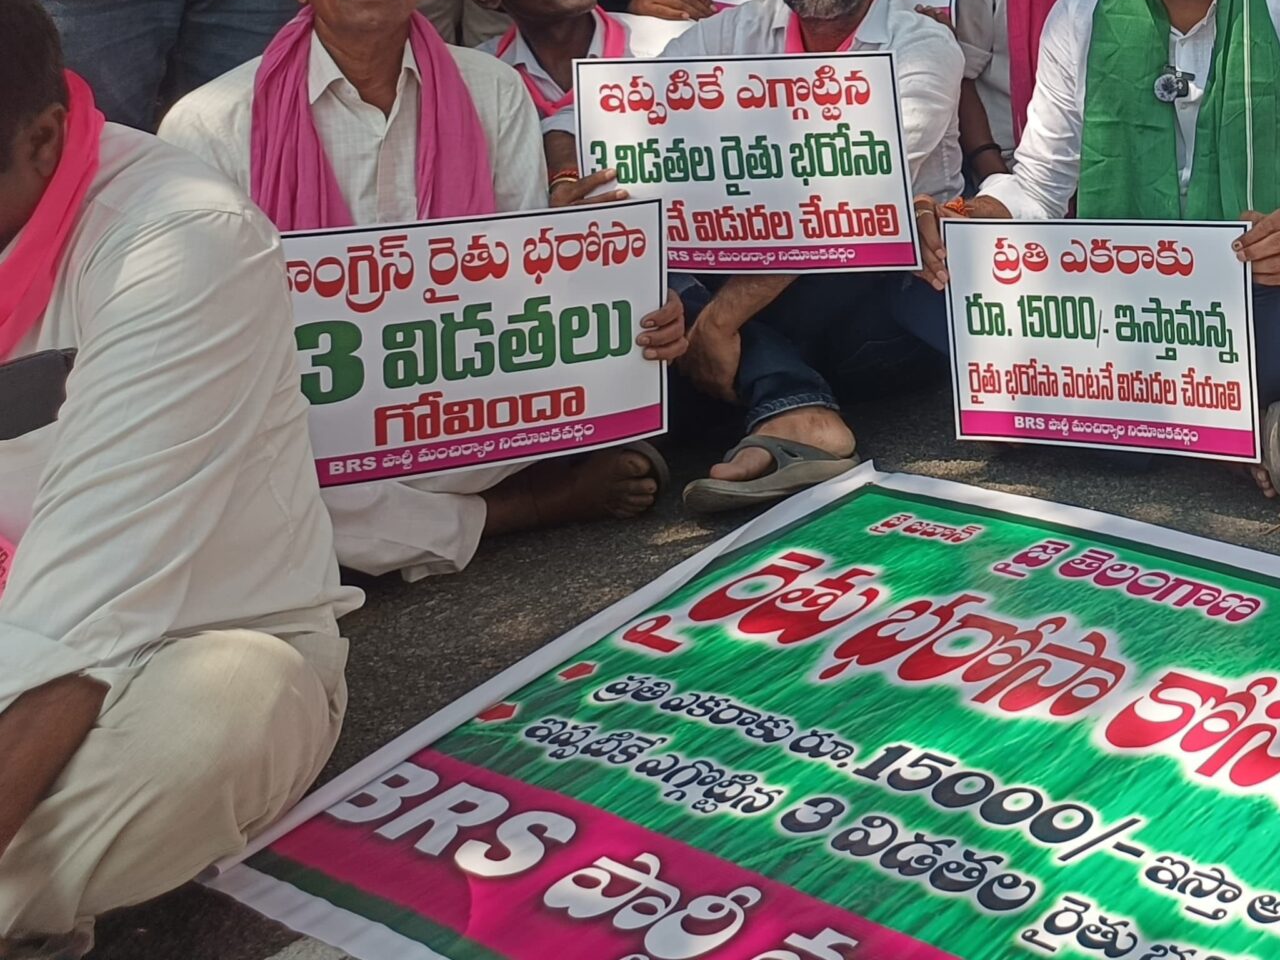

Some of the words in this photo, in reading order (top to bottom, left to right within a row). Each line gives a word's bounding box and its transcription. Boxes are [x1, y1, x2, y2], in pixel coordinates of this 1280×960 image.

[600, 66, 725, 125] ఇప్పటికే
[737, 65, 871, 120] ఎగ్గొట్టిన
[590, 141, 607, 177] 3
[615, 138, 715, 184] విడతల
[721, 135, 783, 196] రైతు
[790, 123, 892, 185] భరోసా
[692, 204, 793, 242] విడుదల
[799, 195, 899, 239] చేయాలి
[423, 235, 510, 304] రైతు
[523, 220, 647, 284] భరోసా
[668, 250, 689, 262] RS
[692, 250, 716, 265] పార్టీ
[718, 250, 776, 265] మంచిర్యాల
[778, 249, 855, 263] నియోజకవర్గం
[992, 237, 1049, 284] ప్రతి
[1061, 239, 1194, 276] ఎకరాకు
[294, 320, 365, 405] 3
[382, 295, 633, 390] విడతలు
[965, 293, 1012, 337] రూ.
[1115, 297, 1239, 364] ఇస్తామన్న
[374, 385, 586, 447] గోవిందా
[968, 362, 1002, 404] రైతు
[1005, 359, 1058, 401] భరోసా
[1061, 362, 1113, 401] వెంటనే
[1118, 370, 1177, 404] విడుదల
[1181, 367, 1241, 411] చేయాలి
[329, 458, 377, 476] BRS
[382, 452, 413, 469] పార్టీ
[417, 440, 495, 464] మంచిర్యాల
[499, 423, 595, 450] నియోజకవర్గం
[1014, 416, 1045, 429] BRS
[1048, 419, 1069, 436] పార్టీ
[1072, 421, 1125, 438] మంచిర్యాల
[1128, 424, 1198, 446] నియోజకవర్గం
[869, 514, 912, 533] జై
[902, 521, 982, 543] జవాన్
[992, 540, 1071, 578] జై
[1058, 551, 1262, 623] తెలంగాణ
[622, 551, 877, 654] రైతు
[818, 592, 1128, 717] భరోసా
[325, 762, 577, 877] BRS
[592, 675, 671, 702] ప్రతి
[663, 692, 794, 745] ఎకరాకు
[789, 729, 855, 768] రూ.
[853, 744, 1145, 862] 15000/-
[1144, 855, 1242, 920] ఇస్తా
[525, 718, 669, 761] ఇప్పటికే
[638, 754, 784, 816] ఎగ్గొట్టిన
[780, 796, 845, 833] 3
[830, 815, 1037, 911] విడతల
[1021, 896, 1138, 953] రైతు
